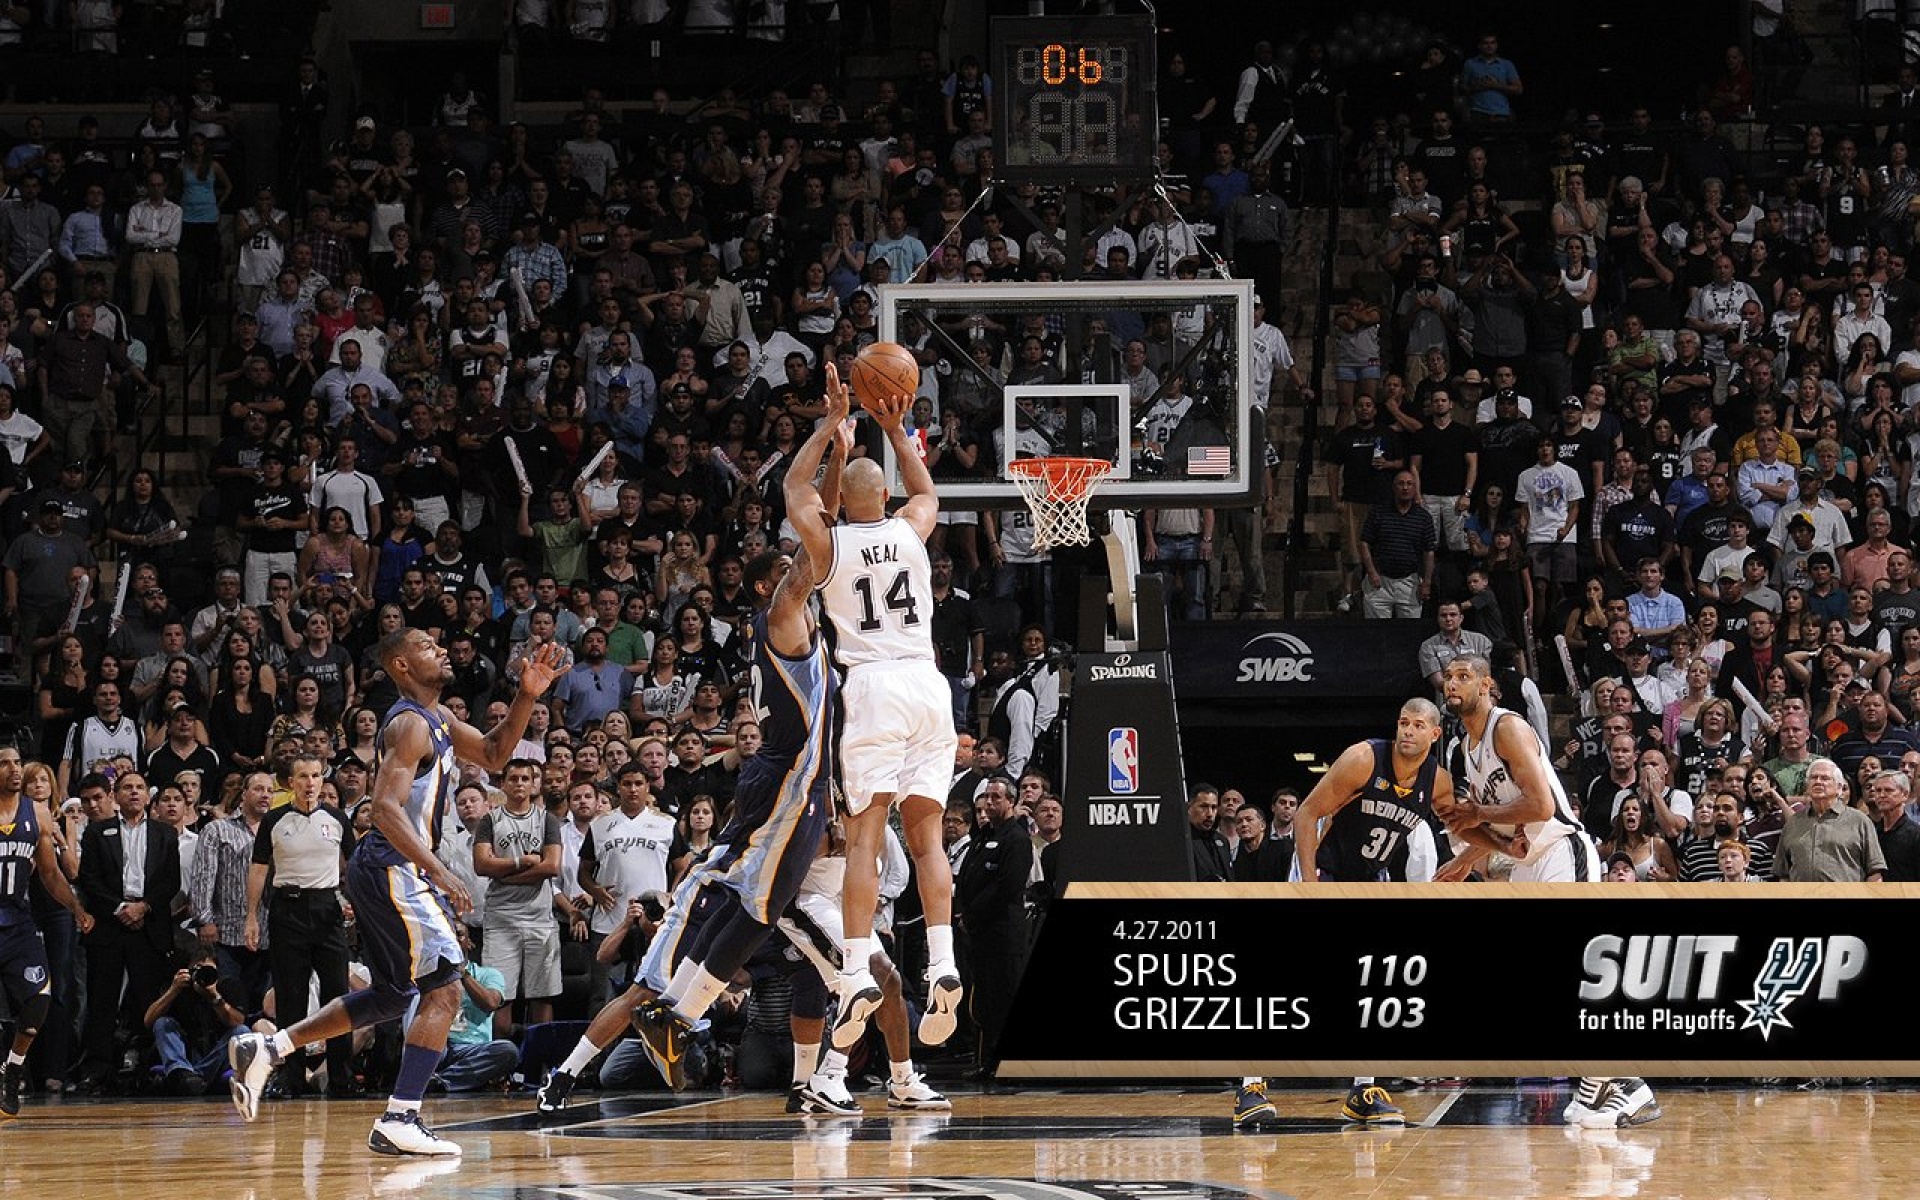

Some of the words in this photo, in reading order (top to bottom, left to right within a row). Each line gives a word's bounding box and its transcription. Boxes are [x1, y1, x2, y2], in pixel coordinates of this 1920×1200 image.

[253, 236, 270, 250] 21
[743, 291, 763, 306] 21
[1662, 463, 1674, 479] 9
[861, 543, 899, 567] NEAL
[853, 568, 921, 633] 14
[1091, 662, 1157, 682] SPALDING
[1237, 657, 1315, 682] SWBC
[1576, 718, 1602, 740] WE
[1089, 803, 1131, 826] NBA
[1133, 803, 1161, 825] TV
[499, 831, 541, 850] SPURS
[604, 838, 658, 852] SPURS
[1361, 827, 1400, 862] 31
